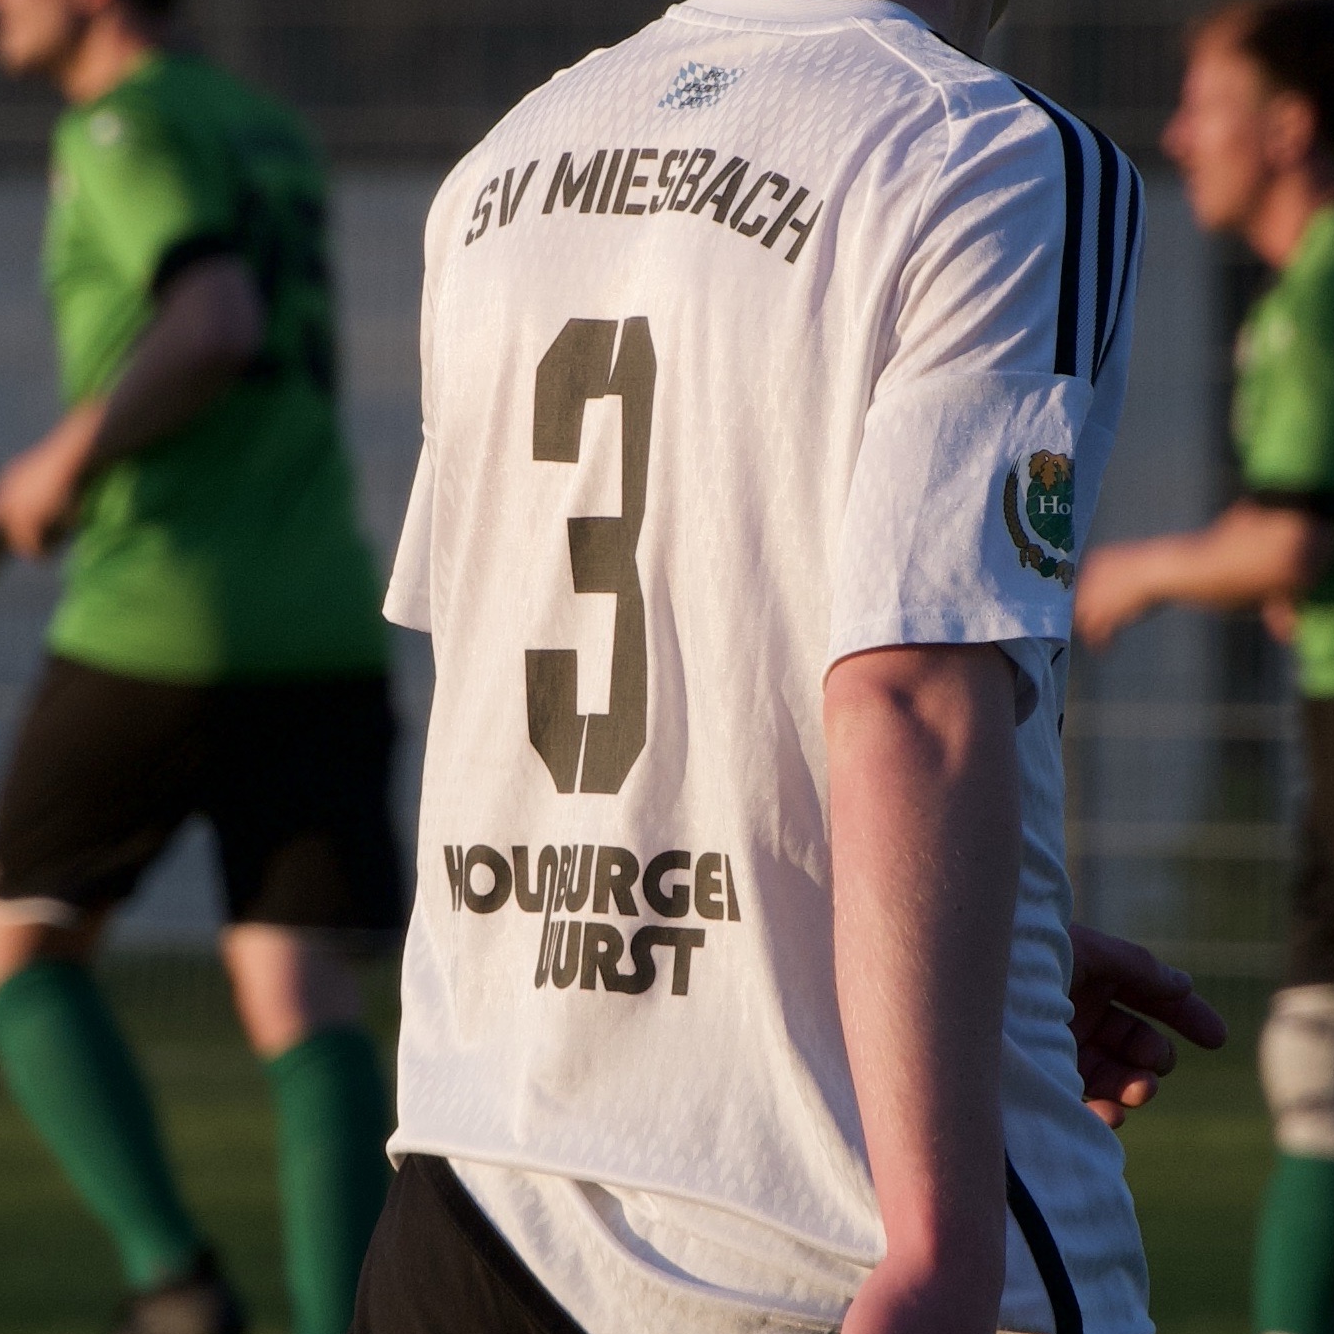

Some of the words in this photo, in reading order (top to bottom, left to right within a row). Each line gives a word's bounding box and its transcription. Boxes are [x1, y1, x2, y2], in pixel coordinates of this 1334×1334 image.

[465, 159, 540, 247] SV
[541, 148, 824, 264] MIESBACH
[525, 316, 657, 794] 3
[1038, 495, 1072, 515] Ho
